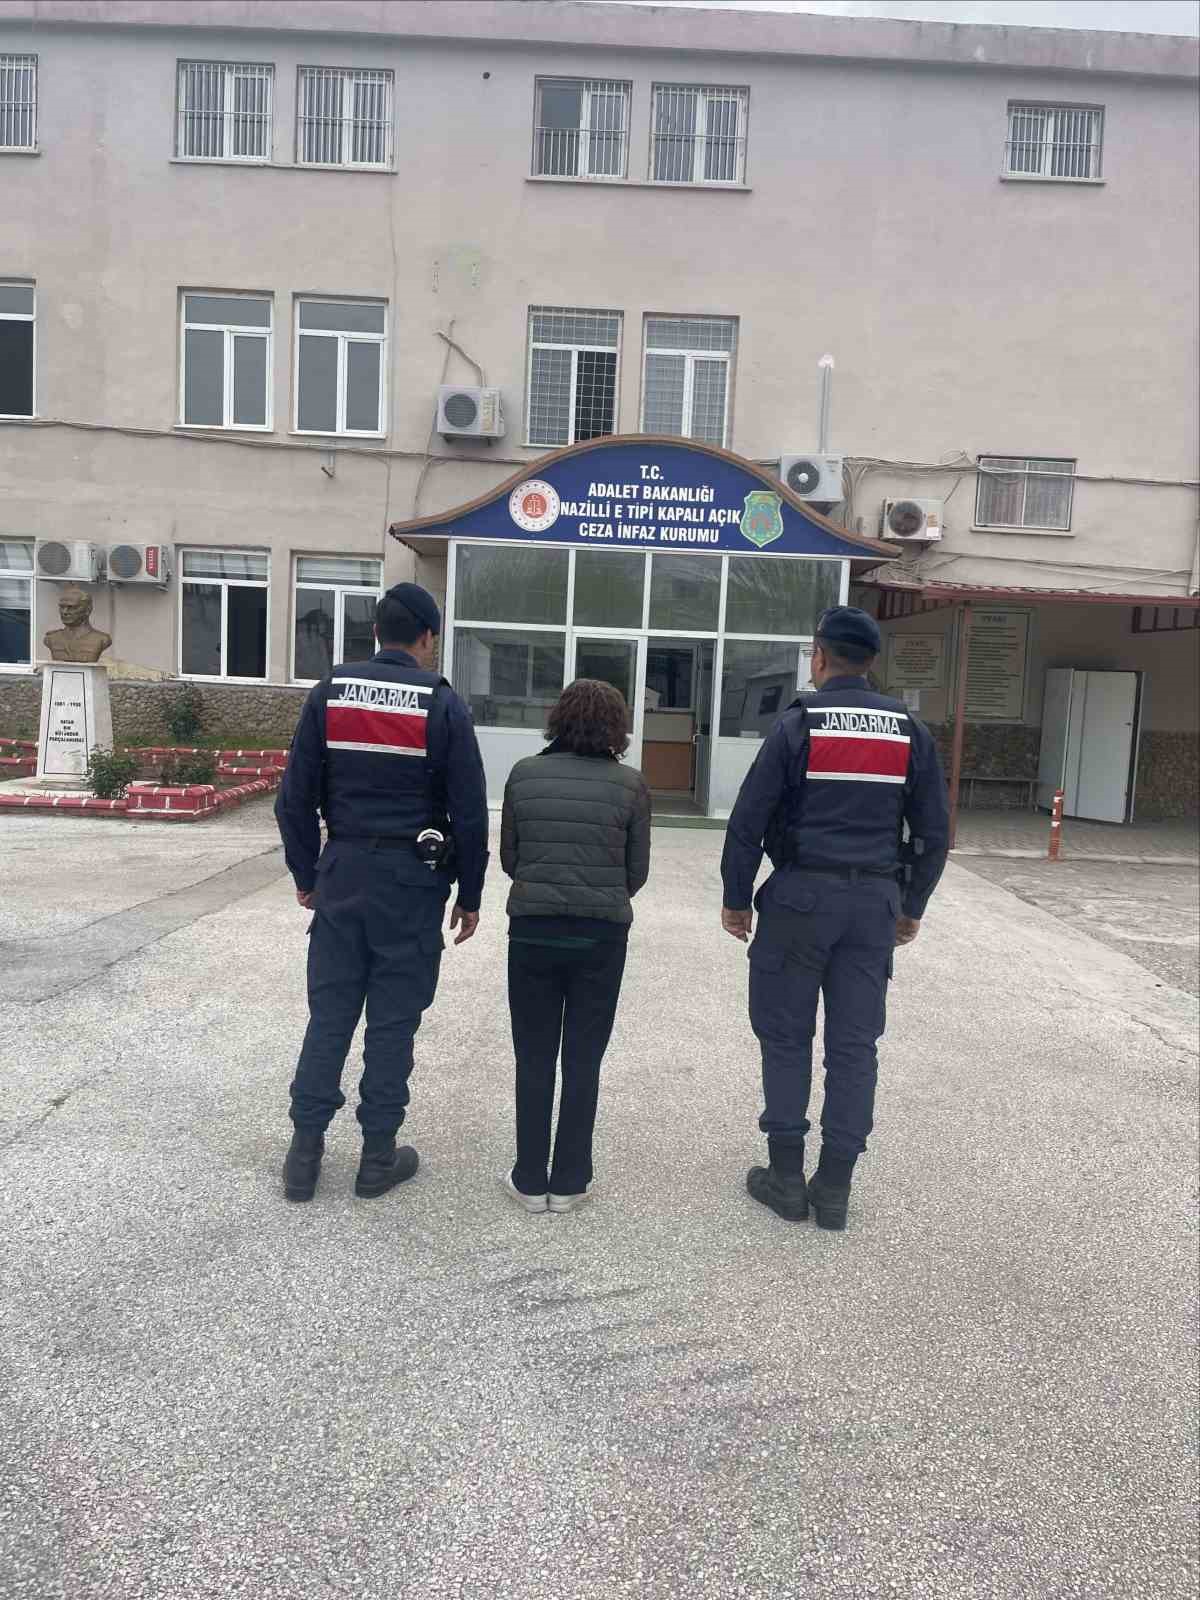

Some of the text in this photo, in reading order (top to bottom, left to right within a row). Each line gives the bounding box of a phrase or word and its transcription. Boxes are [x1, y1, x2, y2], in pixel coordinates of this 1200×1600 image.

[640, 465, 664, 480] T.C.
[588, 482, 714, 503] ADALET BAKANLIĞI
[560, 500, 741, 527] NAZİLLİ E TİPİ KAPALI AÇIK
[579, 521, 719, 543] CEZA İNFAZ KURUMU
[338, 683, 419, 709] JANDARMA
[821, 712, 901, 735] JANDARMA
